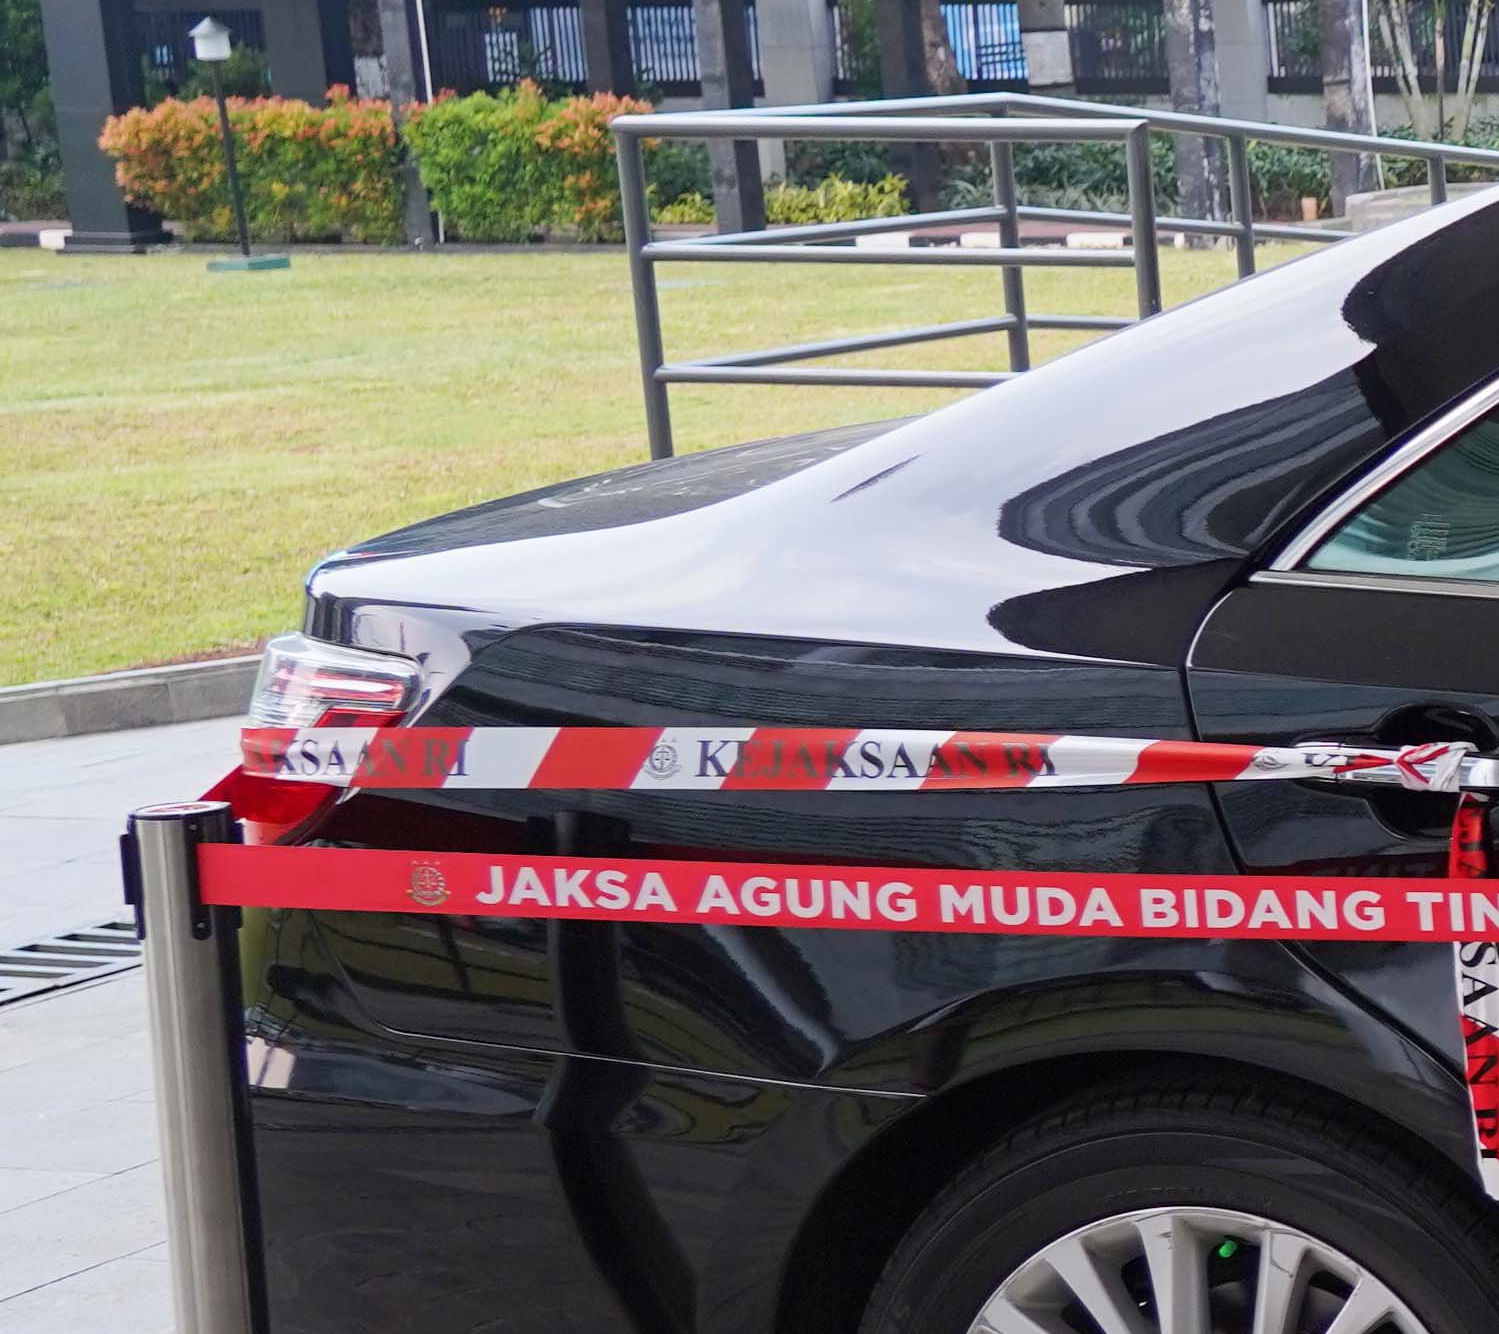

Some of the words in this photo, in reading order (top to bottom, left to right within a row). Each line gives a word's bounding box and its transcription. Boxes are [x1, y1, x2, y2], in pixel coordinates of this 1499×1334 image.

[423, 740, 470, 777] RI
[697, 739, 991, 779] KEJAKSAAN
[1003, 744, 1060, 777] RI
[476, 865, 677, 913] JAKSA
[696, 874, 917, 921] AGUNG
[939, 884, 1123, 927] MUDA
[1140, 888, 1385, 931] BIDANG
